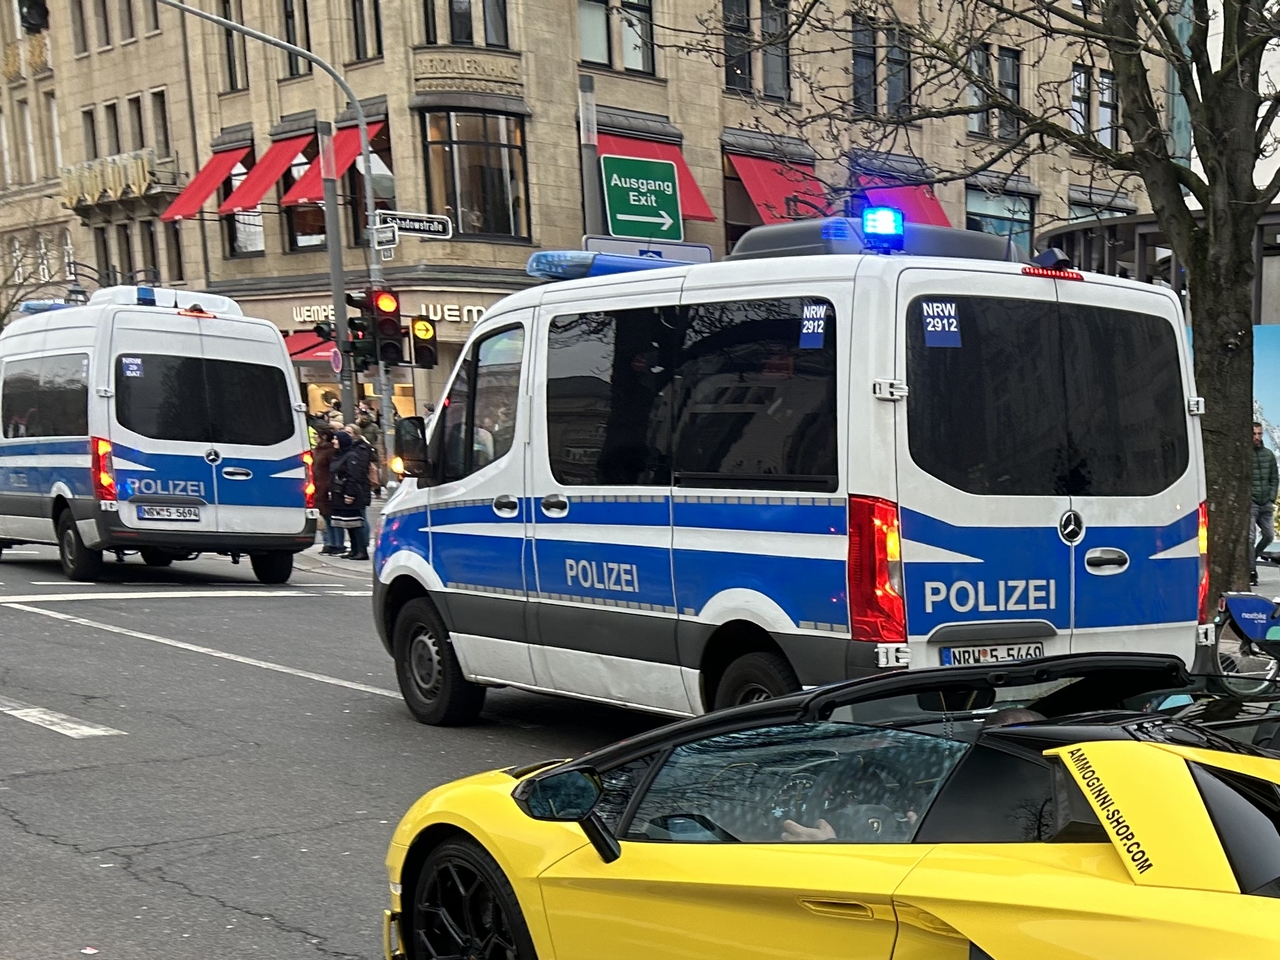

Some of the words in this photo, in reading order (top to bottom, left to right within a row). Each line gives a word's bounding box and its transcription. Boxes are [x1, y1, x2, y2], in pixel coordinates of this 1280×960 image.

[610, 173, 673, 195] Ausgang
[629, 192, 657, 207] Exit
[387, 217, 443, 232] Schadowstraße
[420, 303, 487, 323] WEM
[803, 305, 827, 319] NRW
[922, 303, 956, 317] NRW
[802, 320, 824, 333] 2912
[926, 318, 958, 332] 2912
[127, 478, 205, 496] POLIZEI
[143, 507, 160, 517] NRW
[565, 558, 639, 593] POLIZEI
[924, 579, 1056, 613] POLIZEI
[952, 649, 981, 665] NRW
[1067, 747, 1154, 875] AMMOGINNI-SHOP.COM
